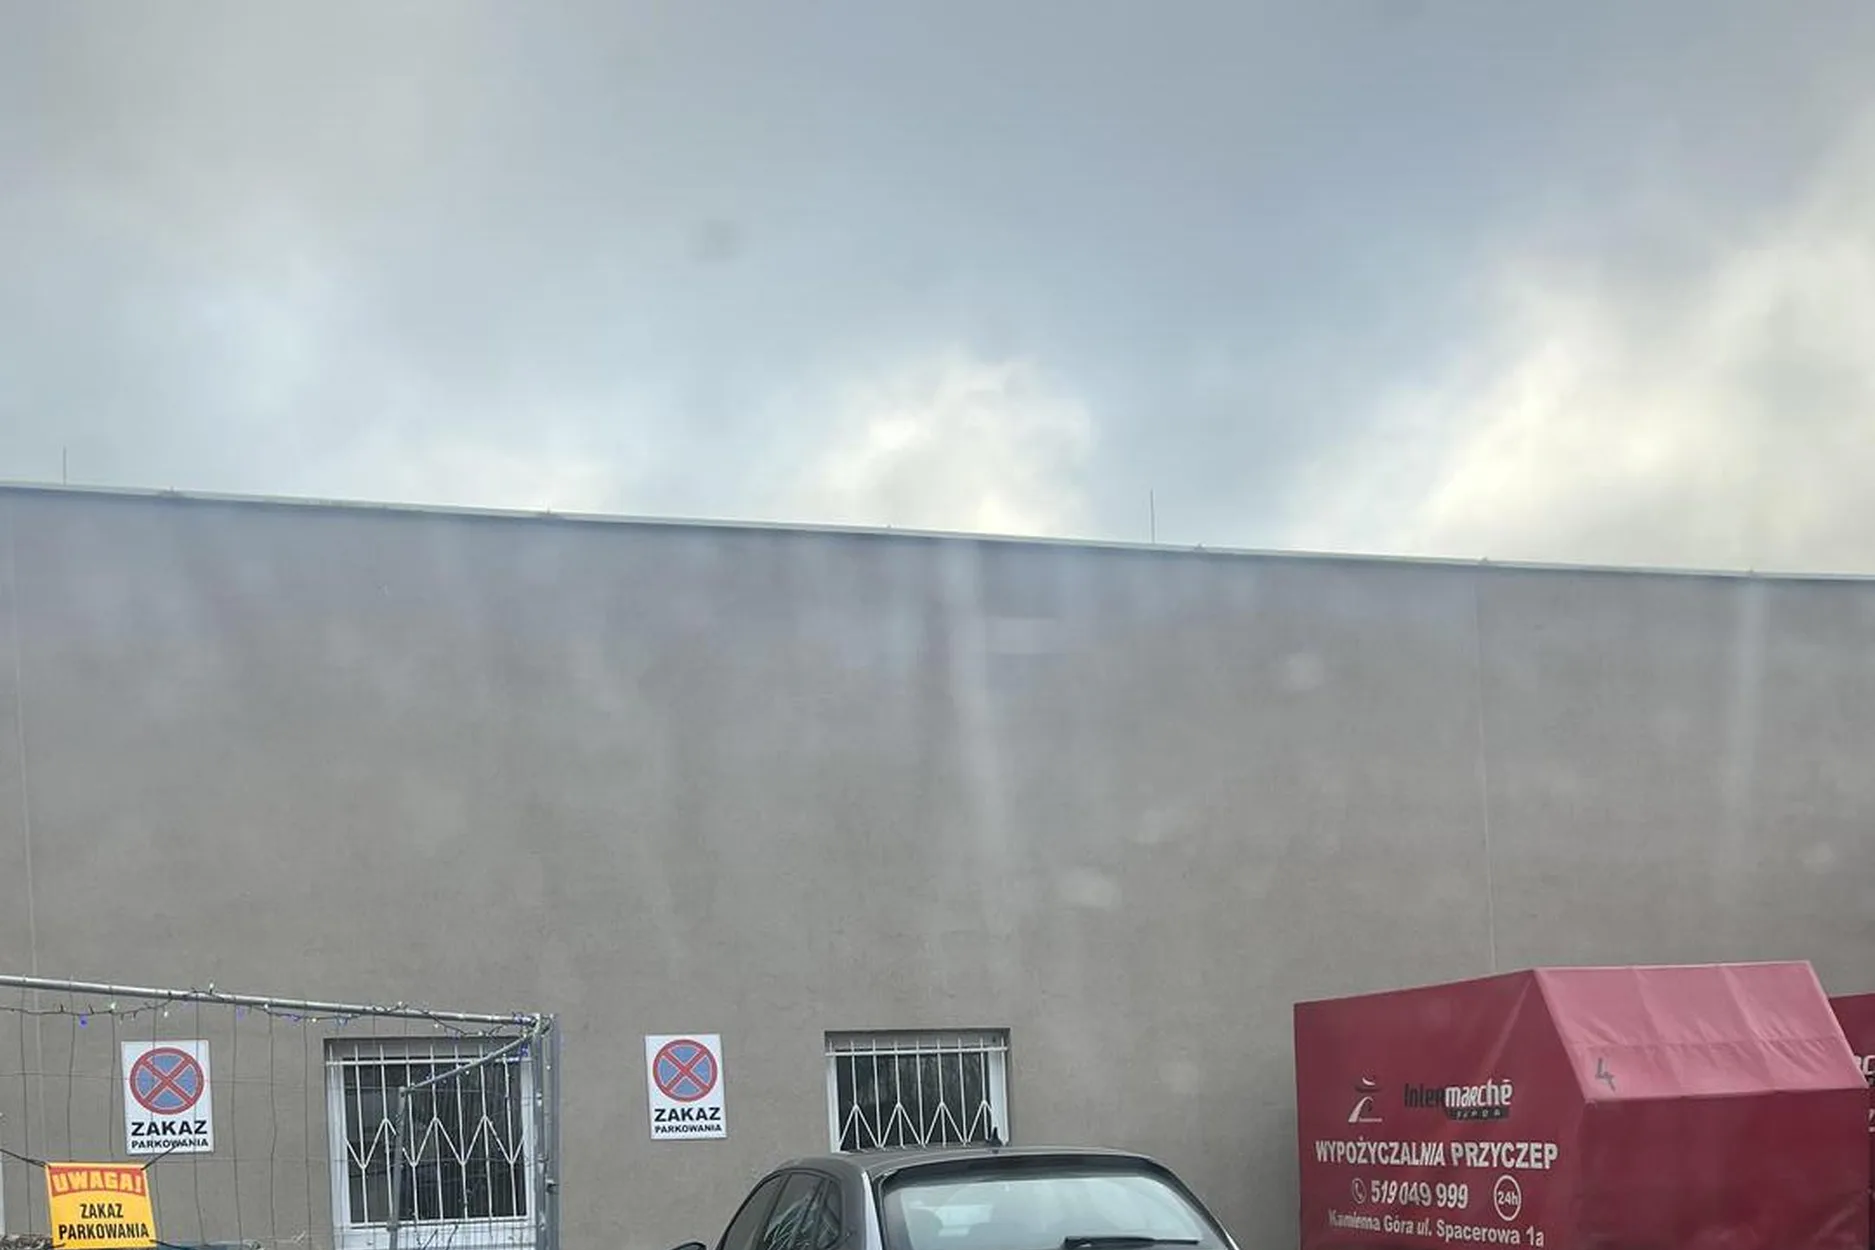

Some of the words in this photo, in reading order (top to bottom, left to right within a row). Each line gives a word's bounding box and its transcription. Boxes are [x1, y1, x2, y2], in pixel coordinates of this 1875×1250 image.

[653, 1107, 721, 1122] ZAKAZ
[131, 1120, 207, 1136] ZAKAZ
[654, 1124, 722, 1133] PARKOWANIA
[131, 1138, 209, 1149] PARKOWANIA
[1315, 1137, 1446, 1167] WYPOŻYCZALNIA
[1451, 1142, 1558, 1169] PRZYCZEP
[52, 1170, 143, 1193] UWAGA!
[1371, 1180, 1398, 1204] 519
[1400, 1181, 1431, 1207] 049
[1436, 1183, 1468, 1209] 999
[1498, 1190, 1518, 1205] 24h
[80, 1203, 124, 1219] ZAKAZ
[58, 1223, 149, 1240] PARKOWANIA
[1384, 1214, 1414, 1235] Góra
[1417, 1217, 1432, 1237] ul.
[1436, 1219, 1520, 1245] Spacerowa
[1526, 1226, 1545, 1247] 1a
